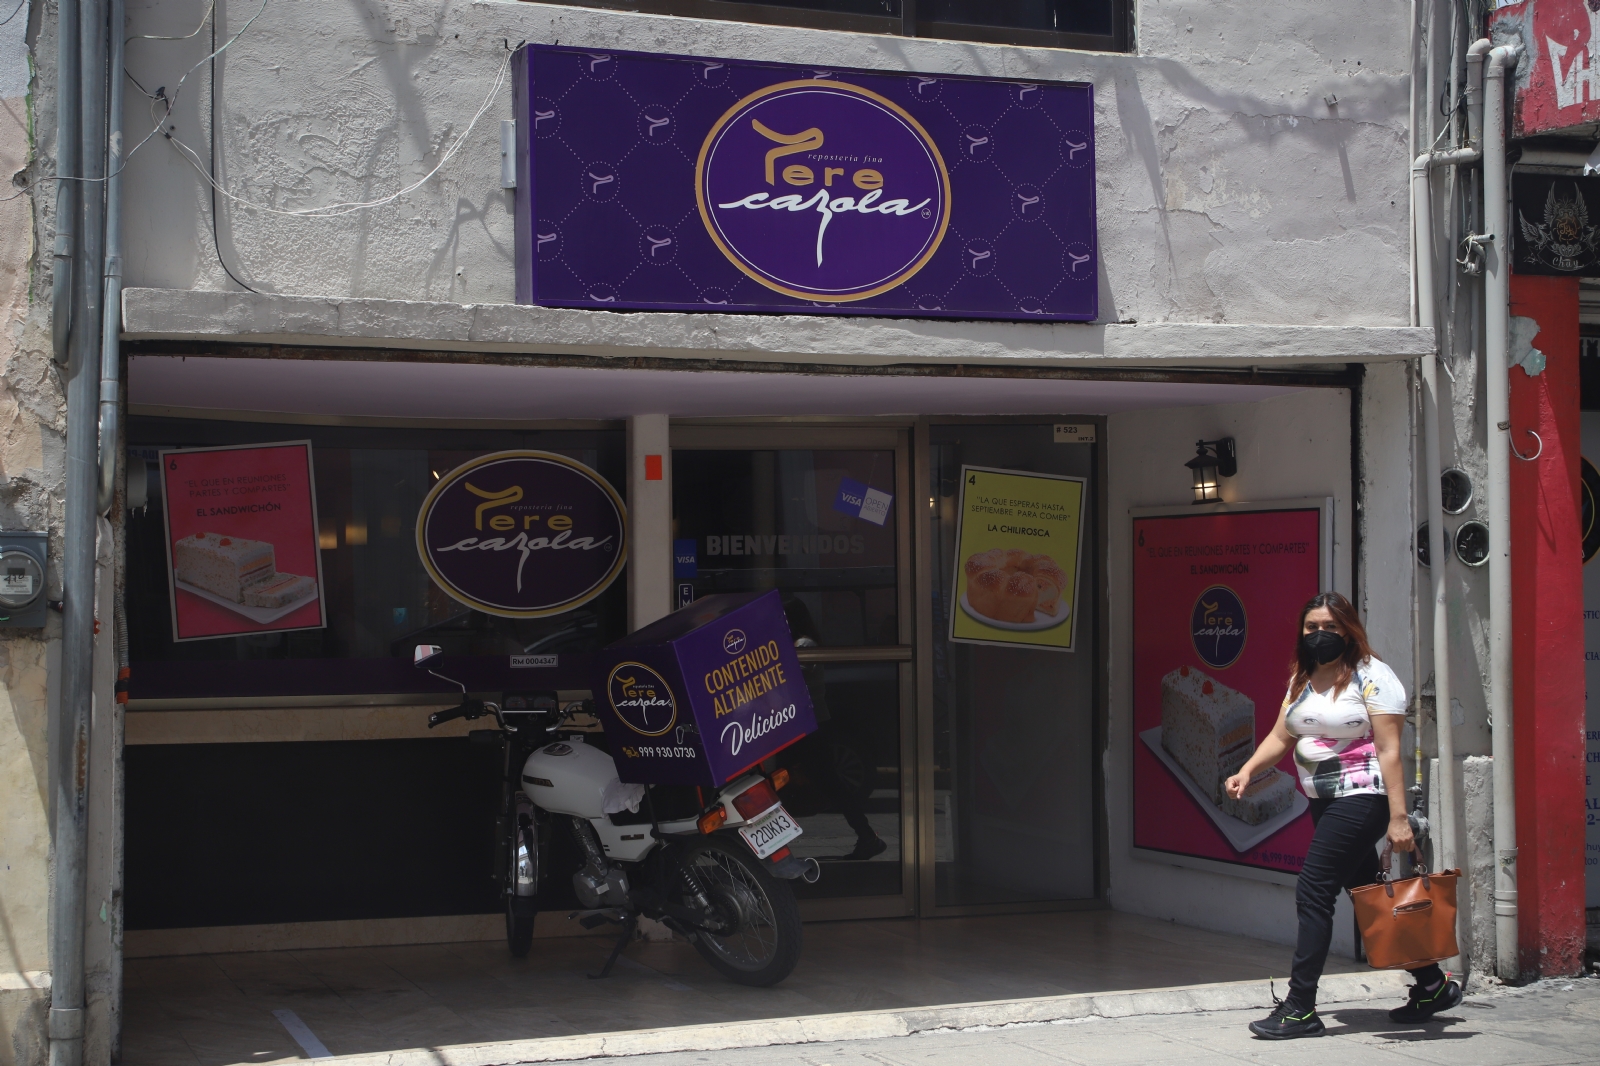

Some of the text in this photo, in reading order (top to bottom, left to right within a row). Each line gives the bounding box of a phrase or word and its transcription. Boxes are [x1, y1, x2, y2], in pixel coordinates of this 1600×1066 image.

[862, 154, 883, 164] fina
[1063, 426, 1078, 434] 523
[169, 459, 178, 471] 6
[201, 478, 220, 487] QUE
[223, 477, 235, 486] EN
[237, 473, 287, 484] REUNIONES
[968, 474, 976, 486] 4
[189, 488, 222, 498] PARTES
[224, 487, 230, 496] Y
[841, 491, 862, 507] VISA
[196, 501, 282, 517] EL SANDWICHÓN
[865, 497, 889, 511] OPEN
[991, 497, 1008, 506] QUE
[1009, 499, 1040, 510] ESPERAS
[1041, 502, 1065, 512] HASTA
[971, 505, 1014, 516] SEPTIEMBRE
[1017, 509, 1038, 519] PARA
[987, 524, 1051, 538] LA CHILIROSCA
[1137, 529, 1145, 547] 6
[706, 534, 865, 556] BIENVENIDOS
[1158, 546, 1172, 558] QUE
[1174, 546, 1183, 557] EN
[1184, 545, 1224, 557] REUNIONES
[1225, 544, 1251, 555] PARTES
[1252, 544, 1257, 554] Y
[676, 555, 696, 564] VISA
[1190, 561, 1249, 575] EL SANDWICHÓN
[704, 640, 779, 694] CONTENIDO
[713, 662, 787, 719] ALTAMENTE
[720, 703, 796, 756] Delicioso
[638, 746, 696, 759] 999 930 0730
[750, 815, 791, 848] 22DKX3
[1270, 851, 1282, 863] 999
[1283, 854, 1296, 866] 930
